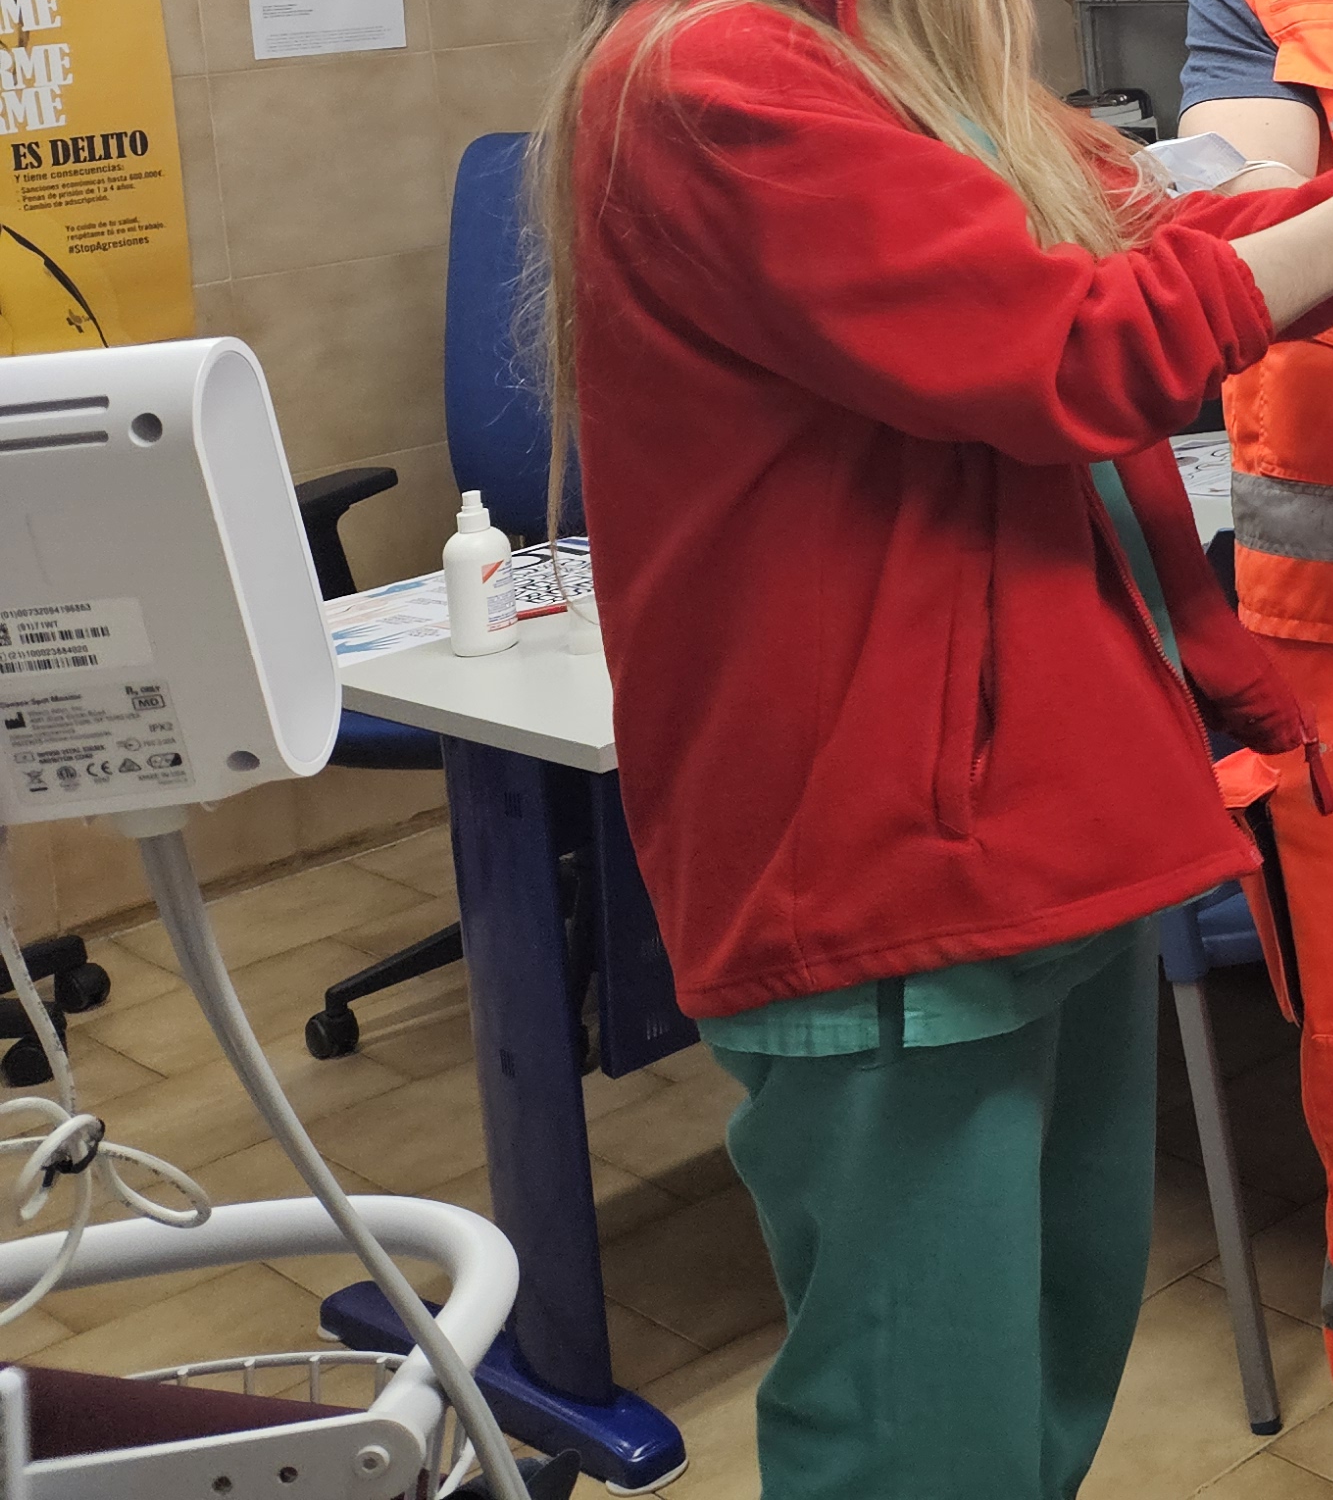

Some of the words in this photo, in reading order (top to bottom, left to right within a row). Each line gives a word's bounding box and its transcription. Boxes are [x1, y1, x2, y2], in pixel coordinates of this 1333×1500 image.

[11, 141, 43, 171] ES
[49, 129, 149, 167] DELITO
[13, 174, 20, 183] Y
[23, 172, 48, 182] tiene
[50, 163, 125, 179] consecuencias:
[21, 183, 60, 194] Sanciones
[61, 178, 106, 189] económicas
[107, 175, 127, 183] hasta
[22, 194, 46, 202] Penas
[59, 189, 84, 199] prisión
[23, 202, 52, 211] Cambio
[53, 200, 63, 208] de
[68, 235, 150, 254] #StopAgresiones
[138, 698, 159, 708] MD
